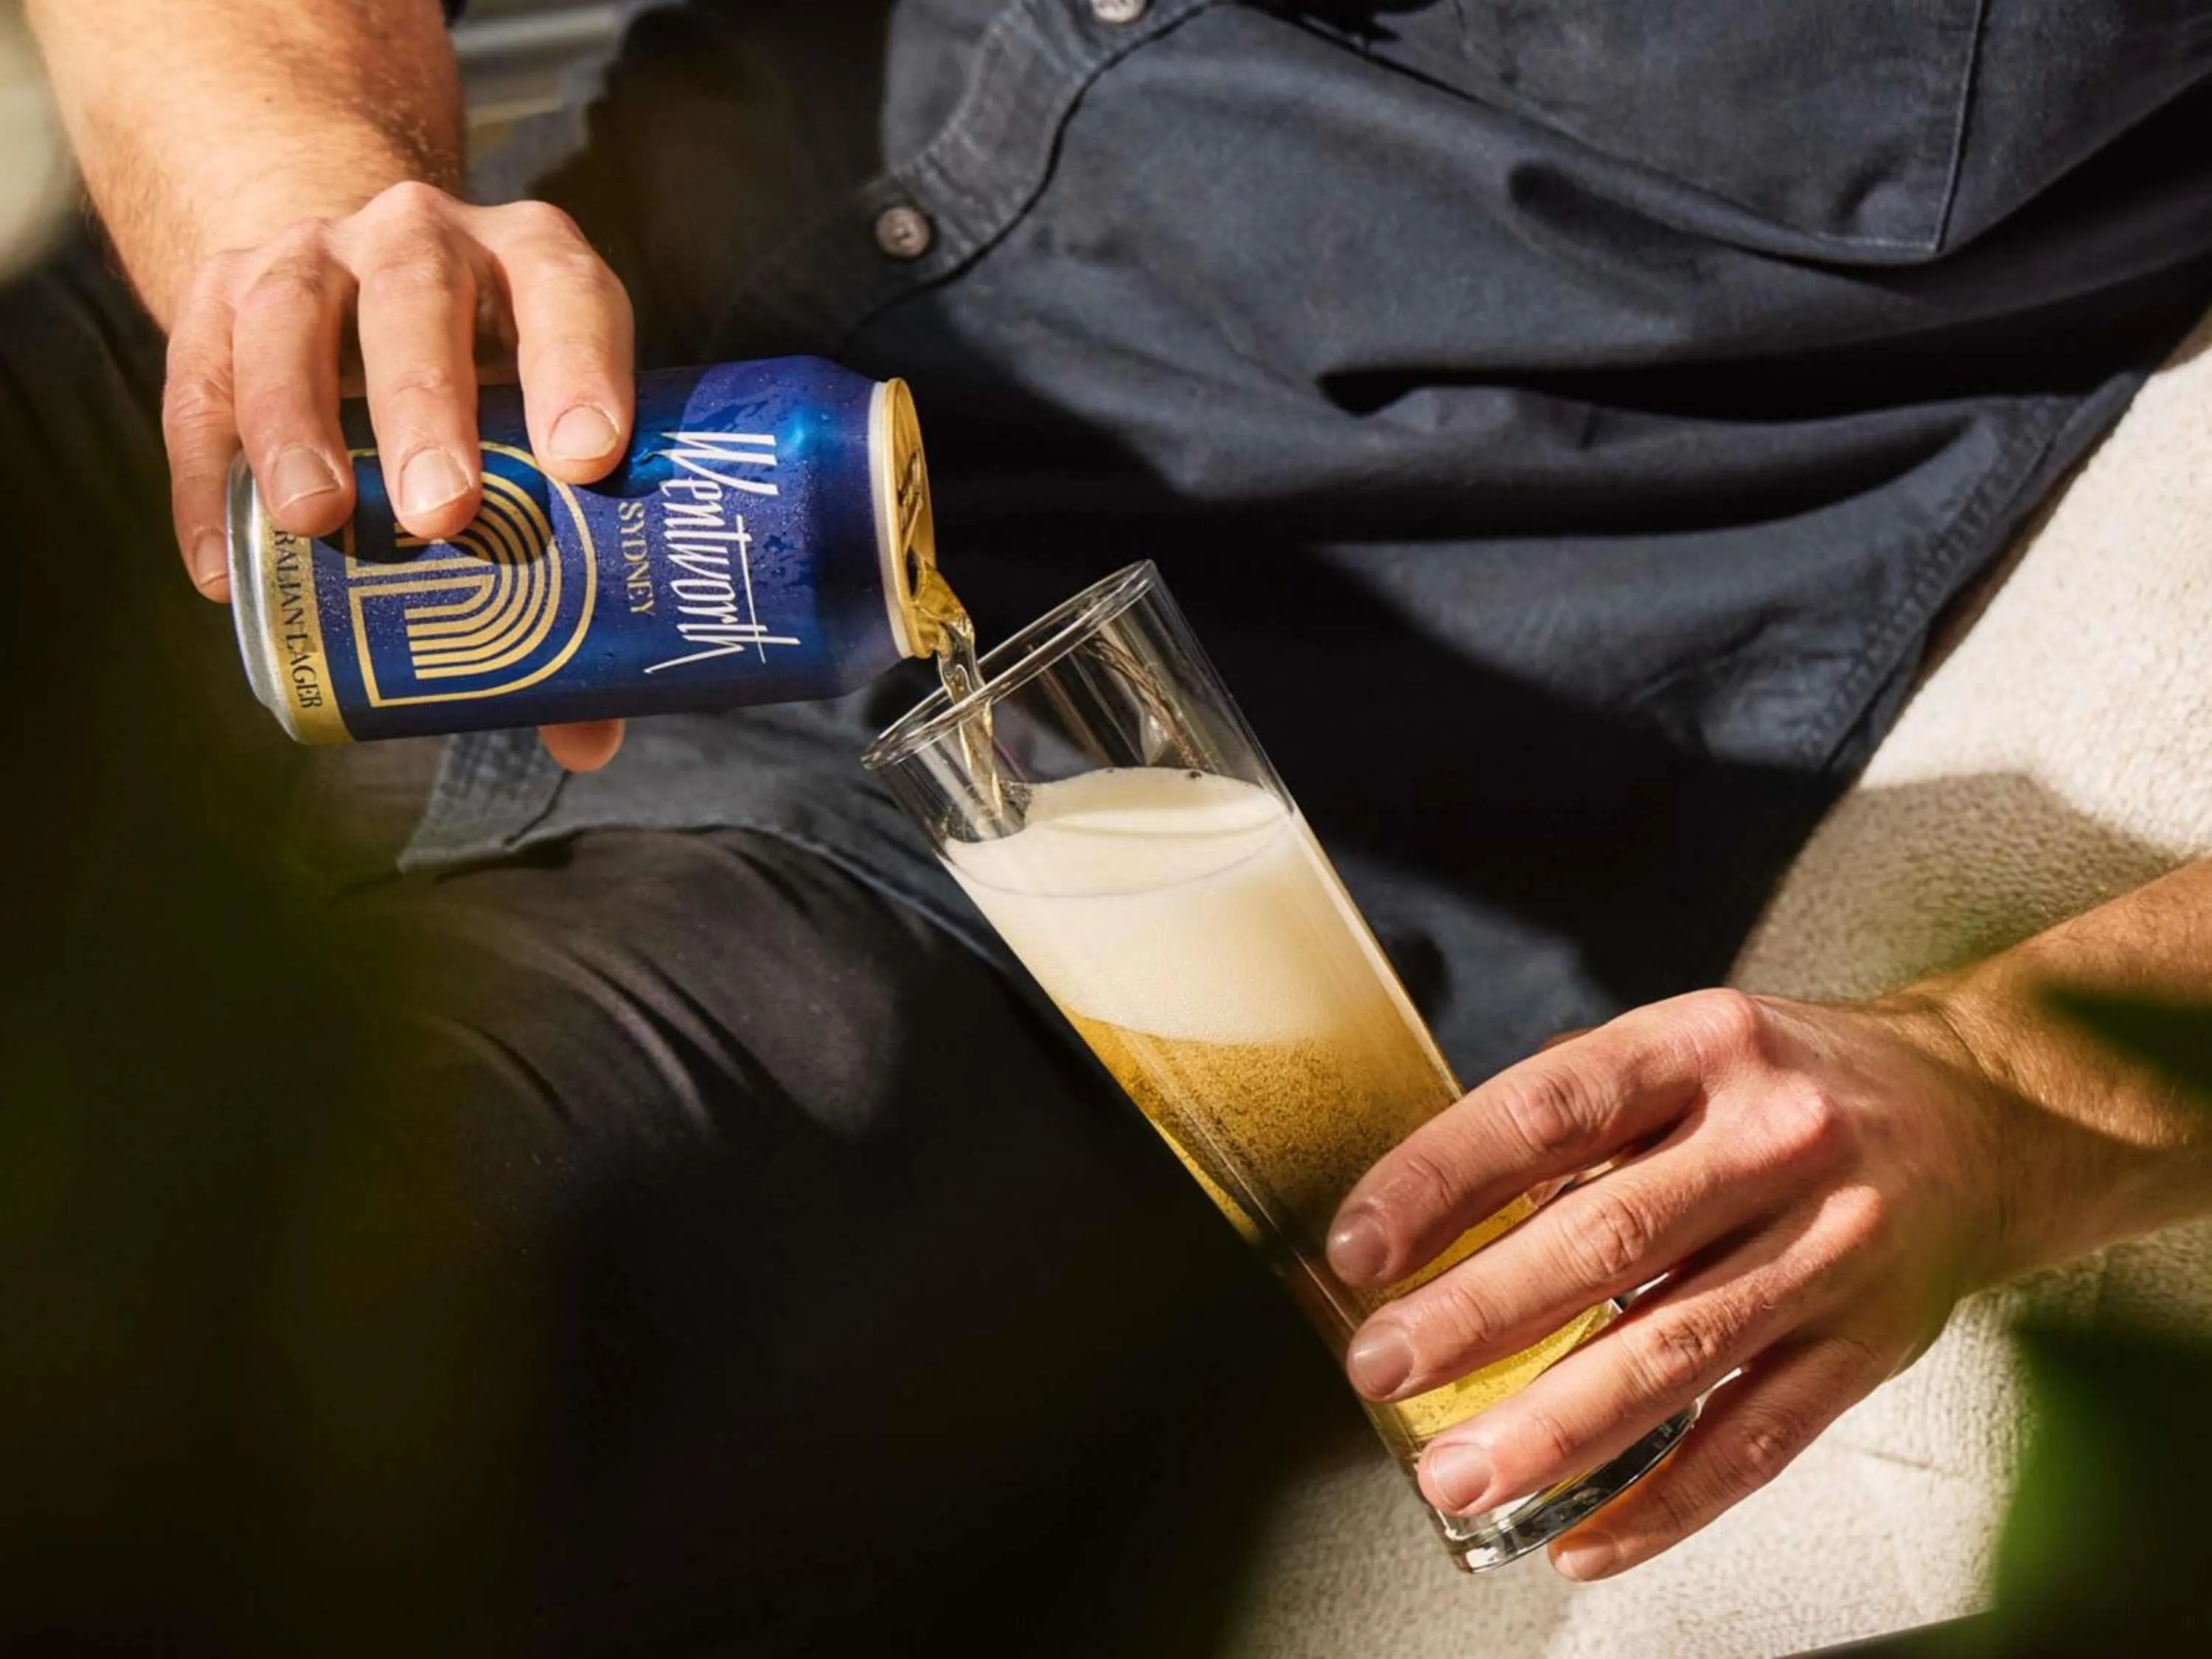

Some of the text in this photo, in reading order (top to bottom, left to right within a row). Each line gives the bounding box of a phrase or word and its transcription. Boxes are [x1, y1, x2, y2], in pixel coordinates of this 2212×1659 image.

[274, 530, 323, 709] RALIAN LAGER
[617, 501, 655, 616] SYDNEY
[643, 431, 801, 674] Wentworth
